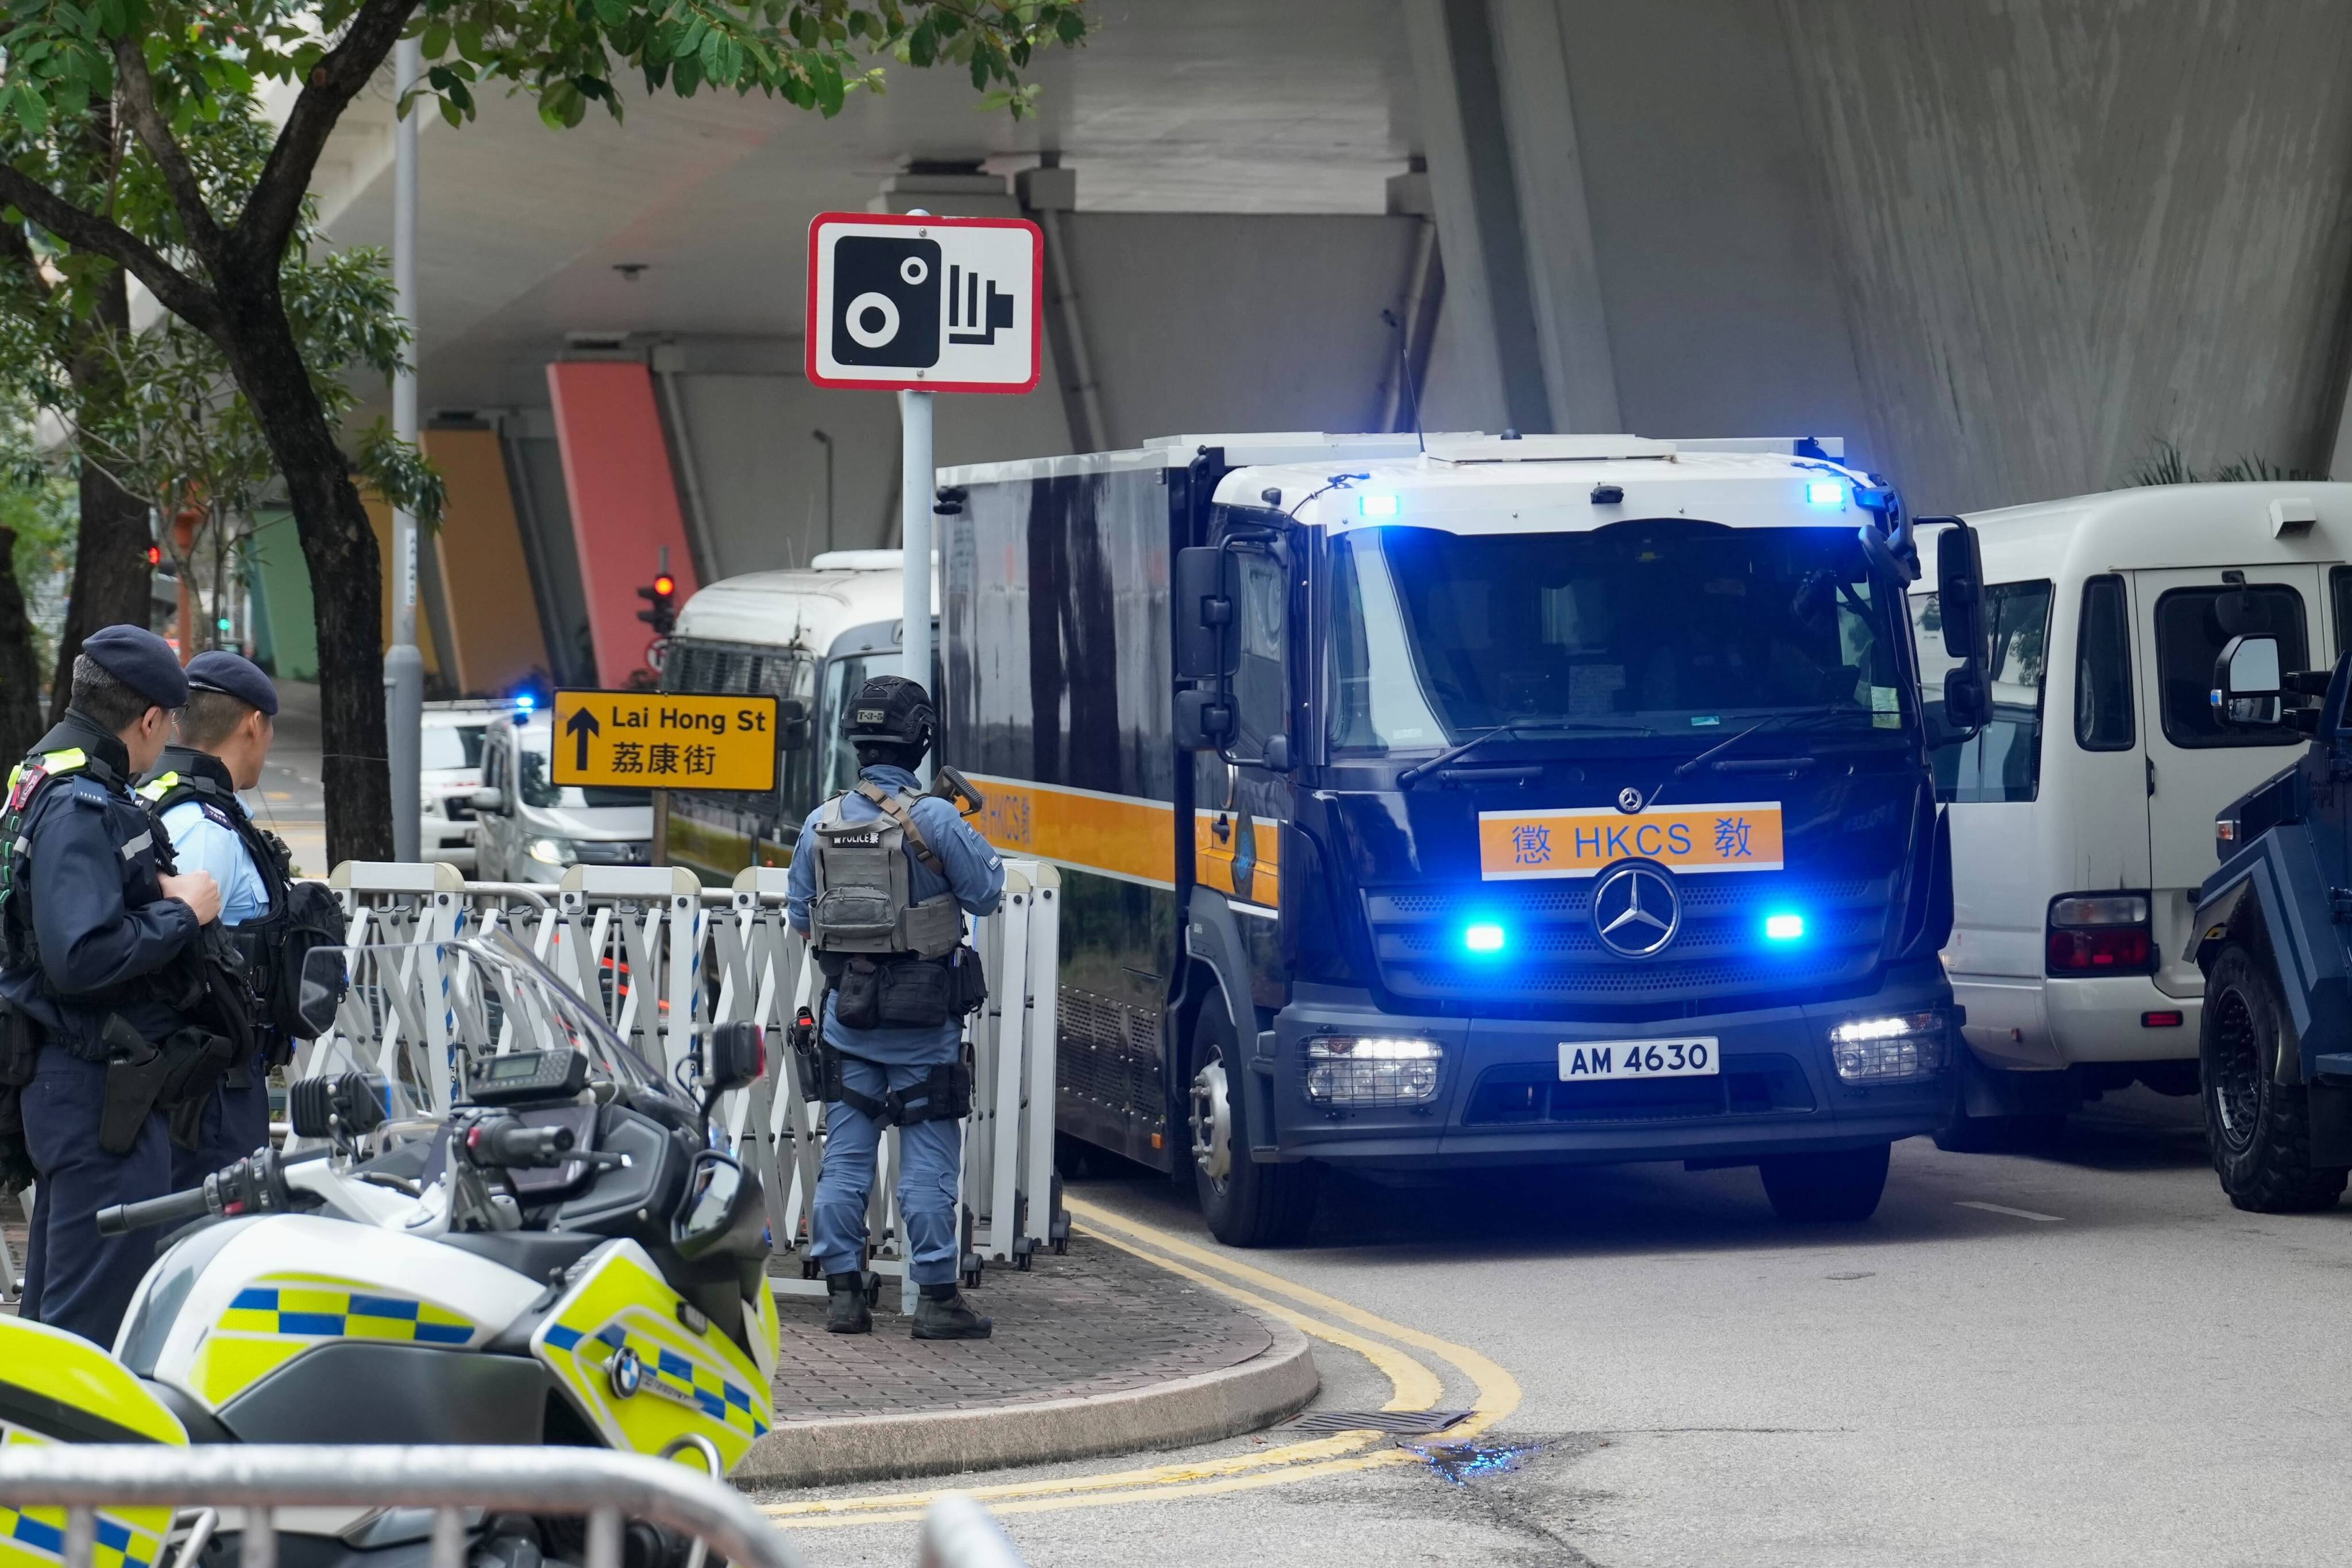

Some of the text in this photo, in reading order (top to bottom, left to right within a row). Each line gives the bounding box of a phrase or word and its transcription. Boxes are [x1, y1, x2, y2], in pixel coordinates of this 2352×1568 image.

[612, 706, 766, 735] Lai Hong St
[859, 712, 883, 721] T-3-5
[612, 741, 716, 775] 荔康街
[1512, 825, 1551, 864] 懲
[1575, 823, 1691, 858] HKCS
[1570, 1044, 1708, 1075] AM 4630
